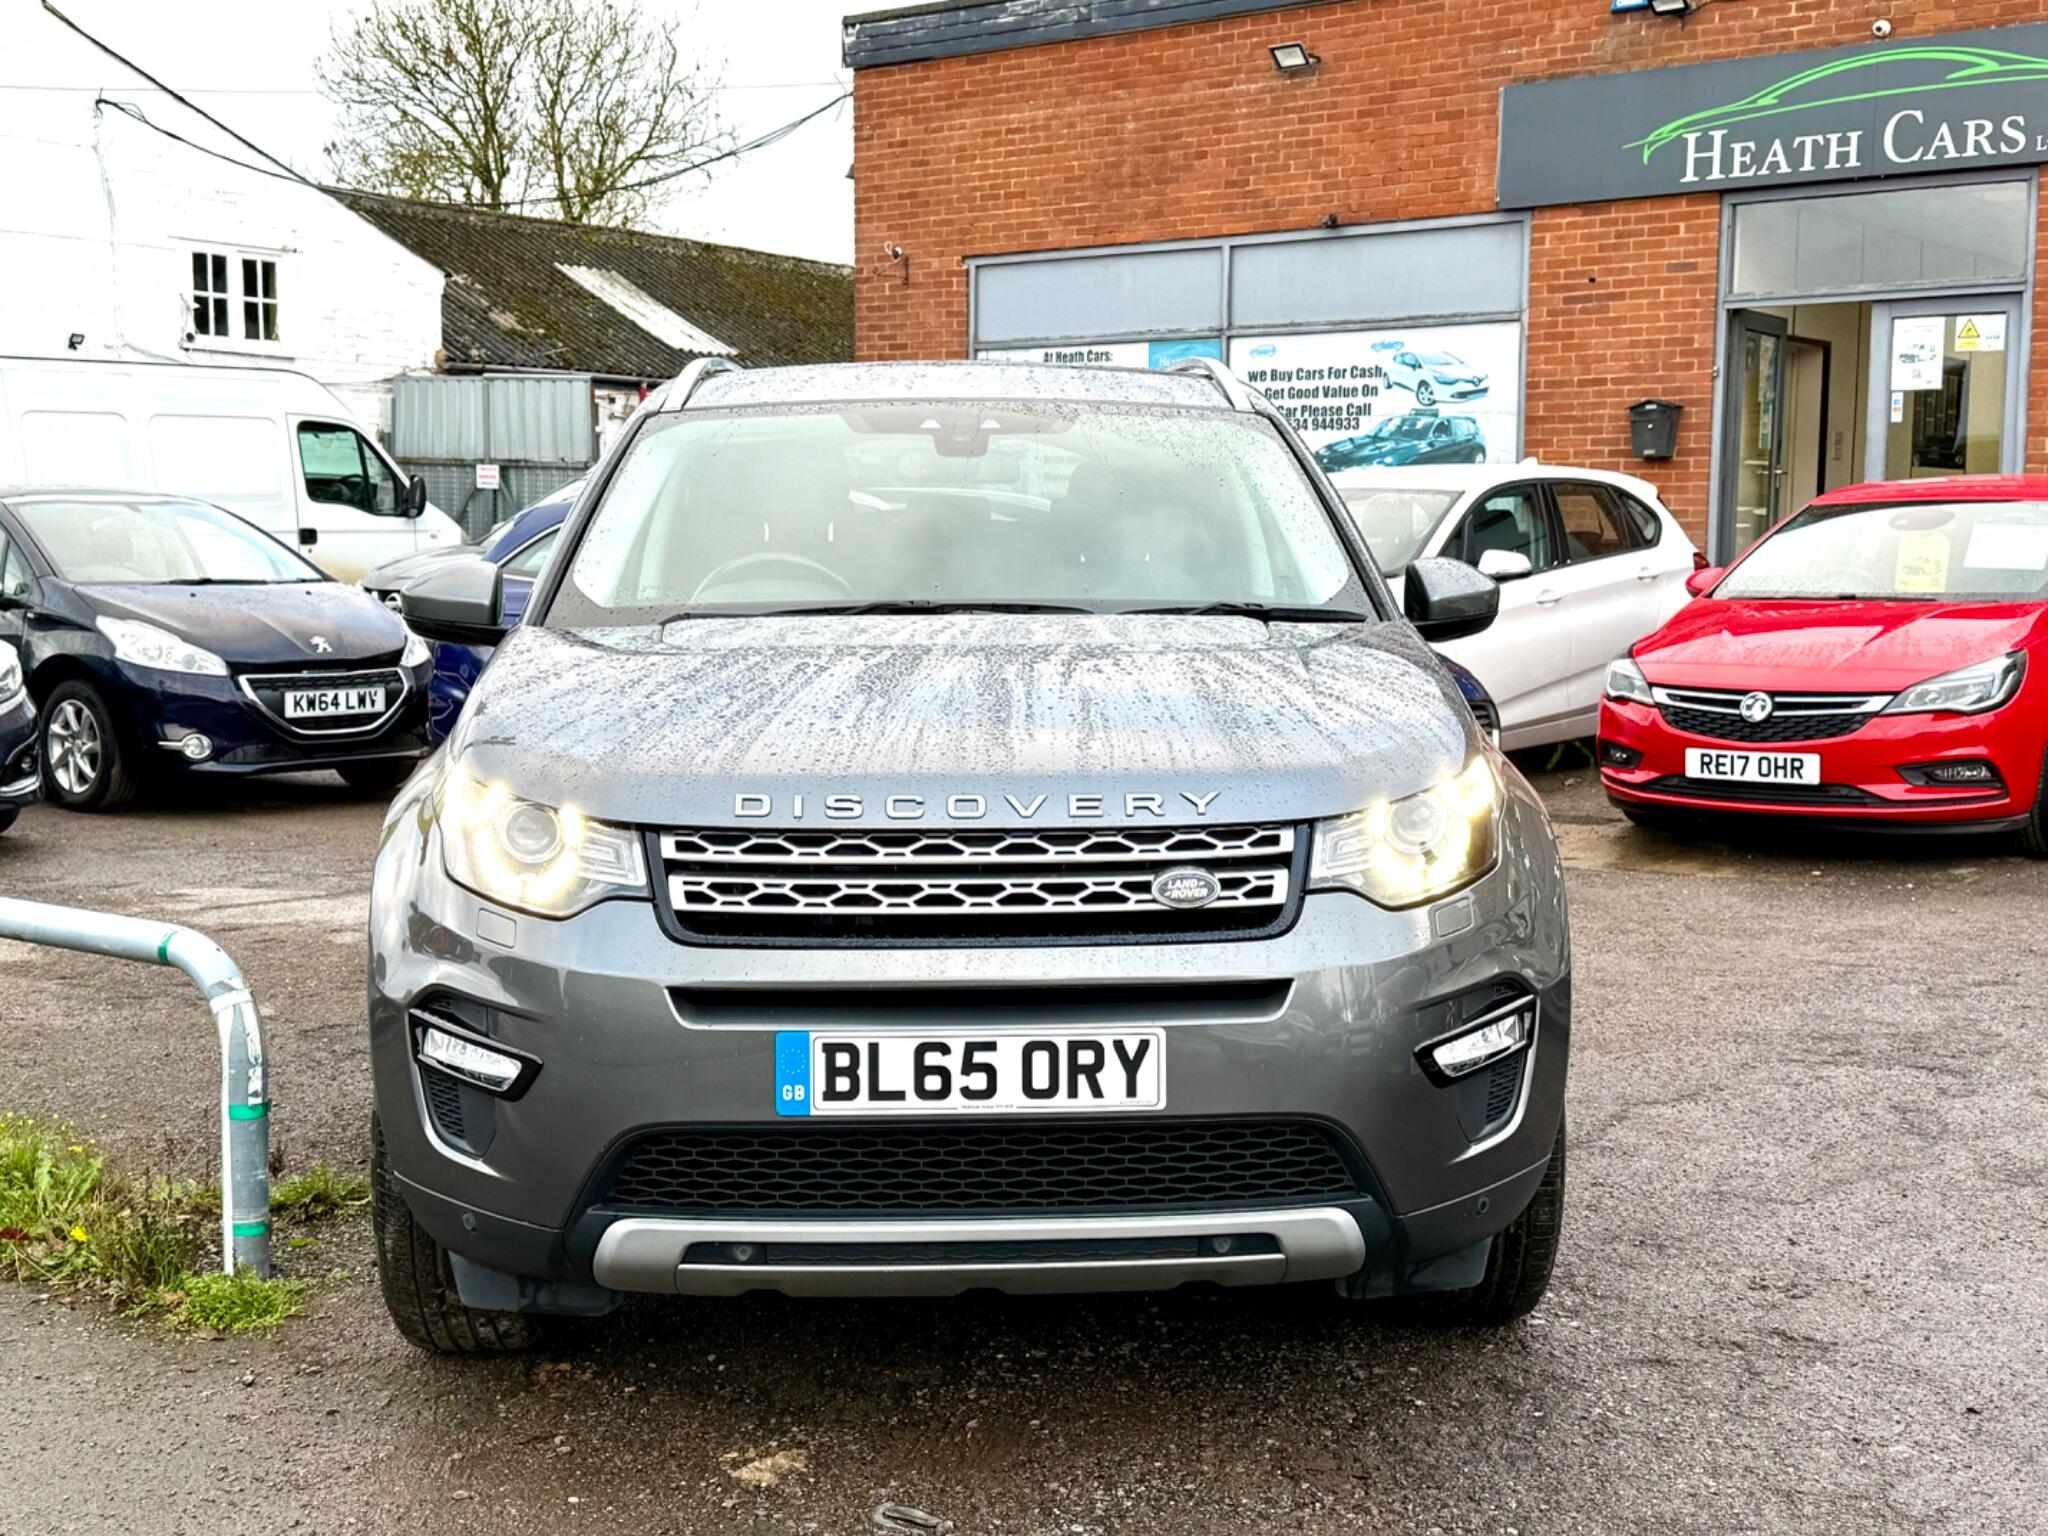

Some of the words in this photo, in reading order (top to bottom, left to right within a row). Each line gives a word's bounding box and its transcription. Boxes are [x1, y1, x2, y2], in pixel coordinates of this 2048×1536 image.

[1680, 129, 1863, 182] HEATH
[1883, 109, 2027, 164] CARS
[2035, 135, 2048, 151] L
[1056, 350, 1085, 363] Heath
[1248, 370, 1267, 382] we
[1270, 369, 1293, 382] Buy
[1296, 367, 1325, 380] Cars
[1328, 366, 1347, 379] For
[1350, 365, 1383, 378] Cash
[1264, 387, 1285, 400] Get
[1288, 386, 1319, 399] Good
[1322, 385, 1359, 398] Value
[1361, 384, 1378, 397] On
[1277, 405, 1298, 418] Car
[1301, 404, 1343, 417] Please
[1346, 403, 1372, 416] Call
[1311, 417, 1360, 430] 944933
[293, 692, 340, 712] KW64
[1700, 752, 1750, 776] RE17
[1758, 756, 1804, 780] OHR
[733, 791, 1221, 819] DISCOVERY
[1167, 879, 1198, 889] LAND
[1170, 888, 1208, 899] ROVER
[822, 1041, 998, 1102] BL65
[1021, 1039, 1151, 1101] ORY
[782, 1084, 805, 1101] GB
